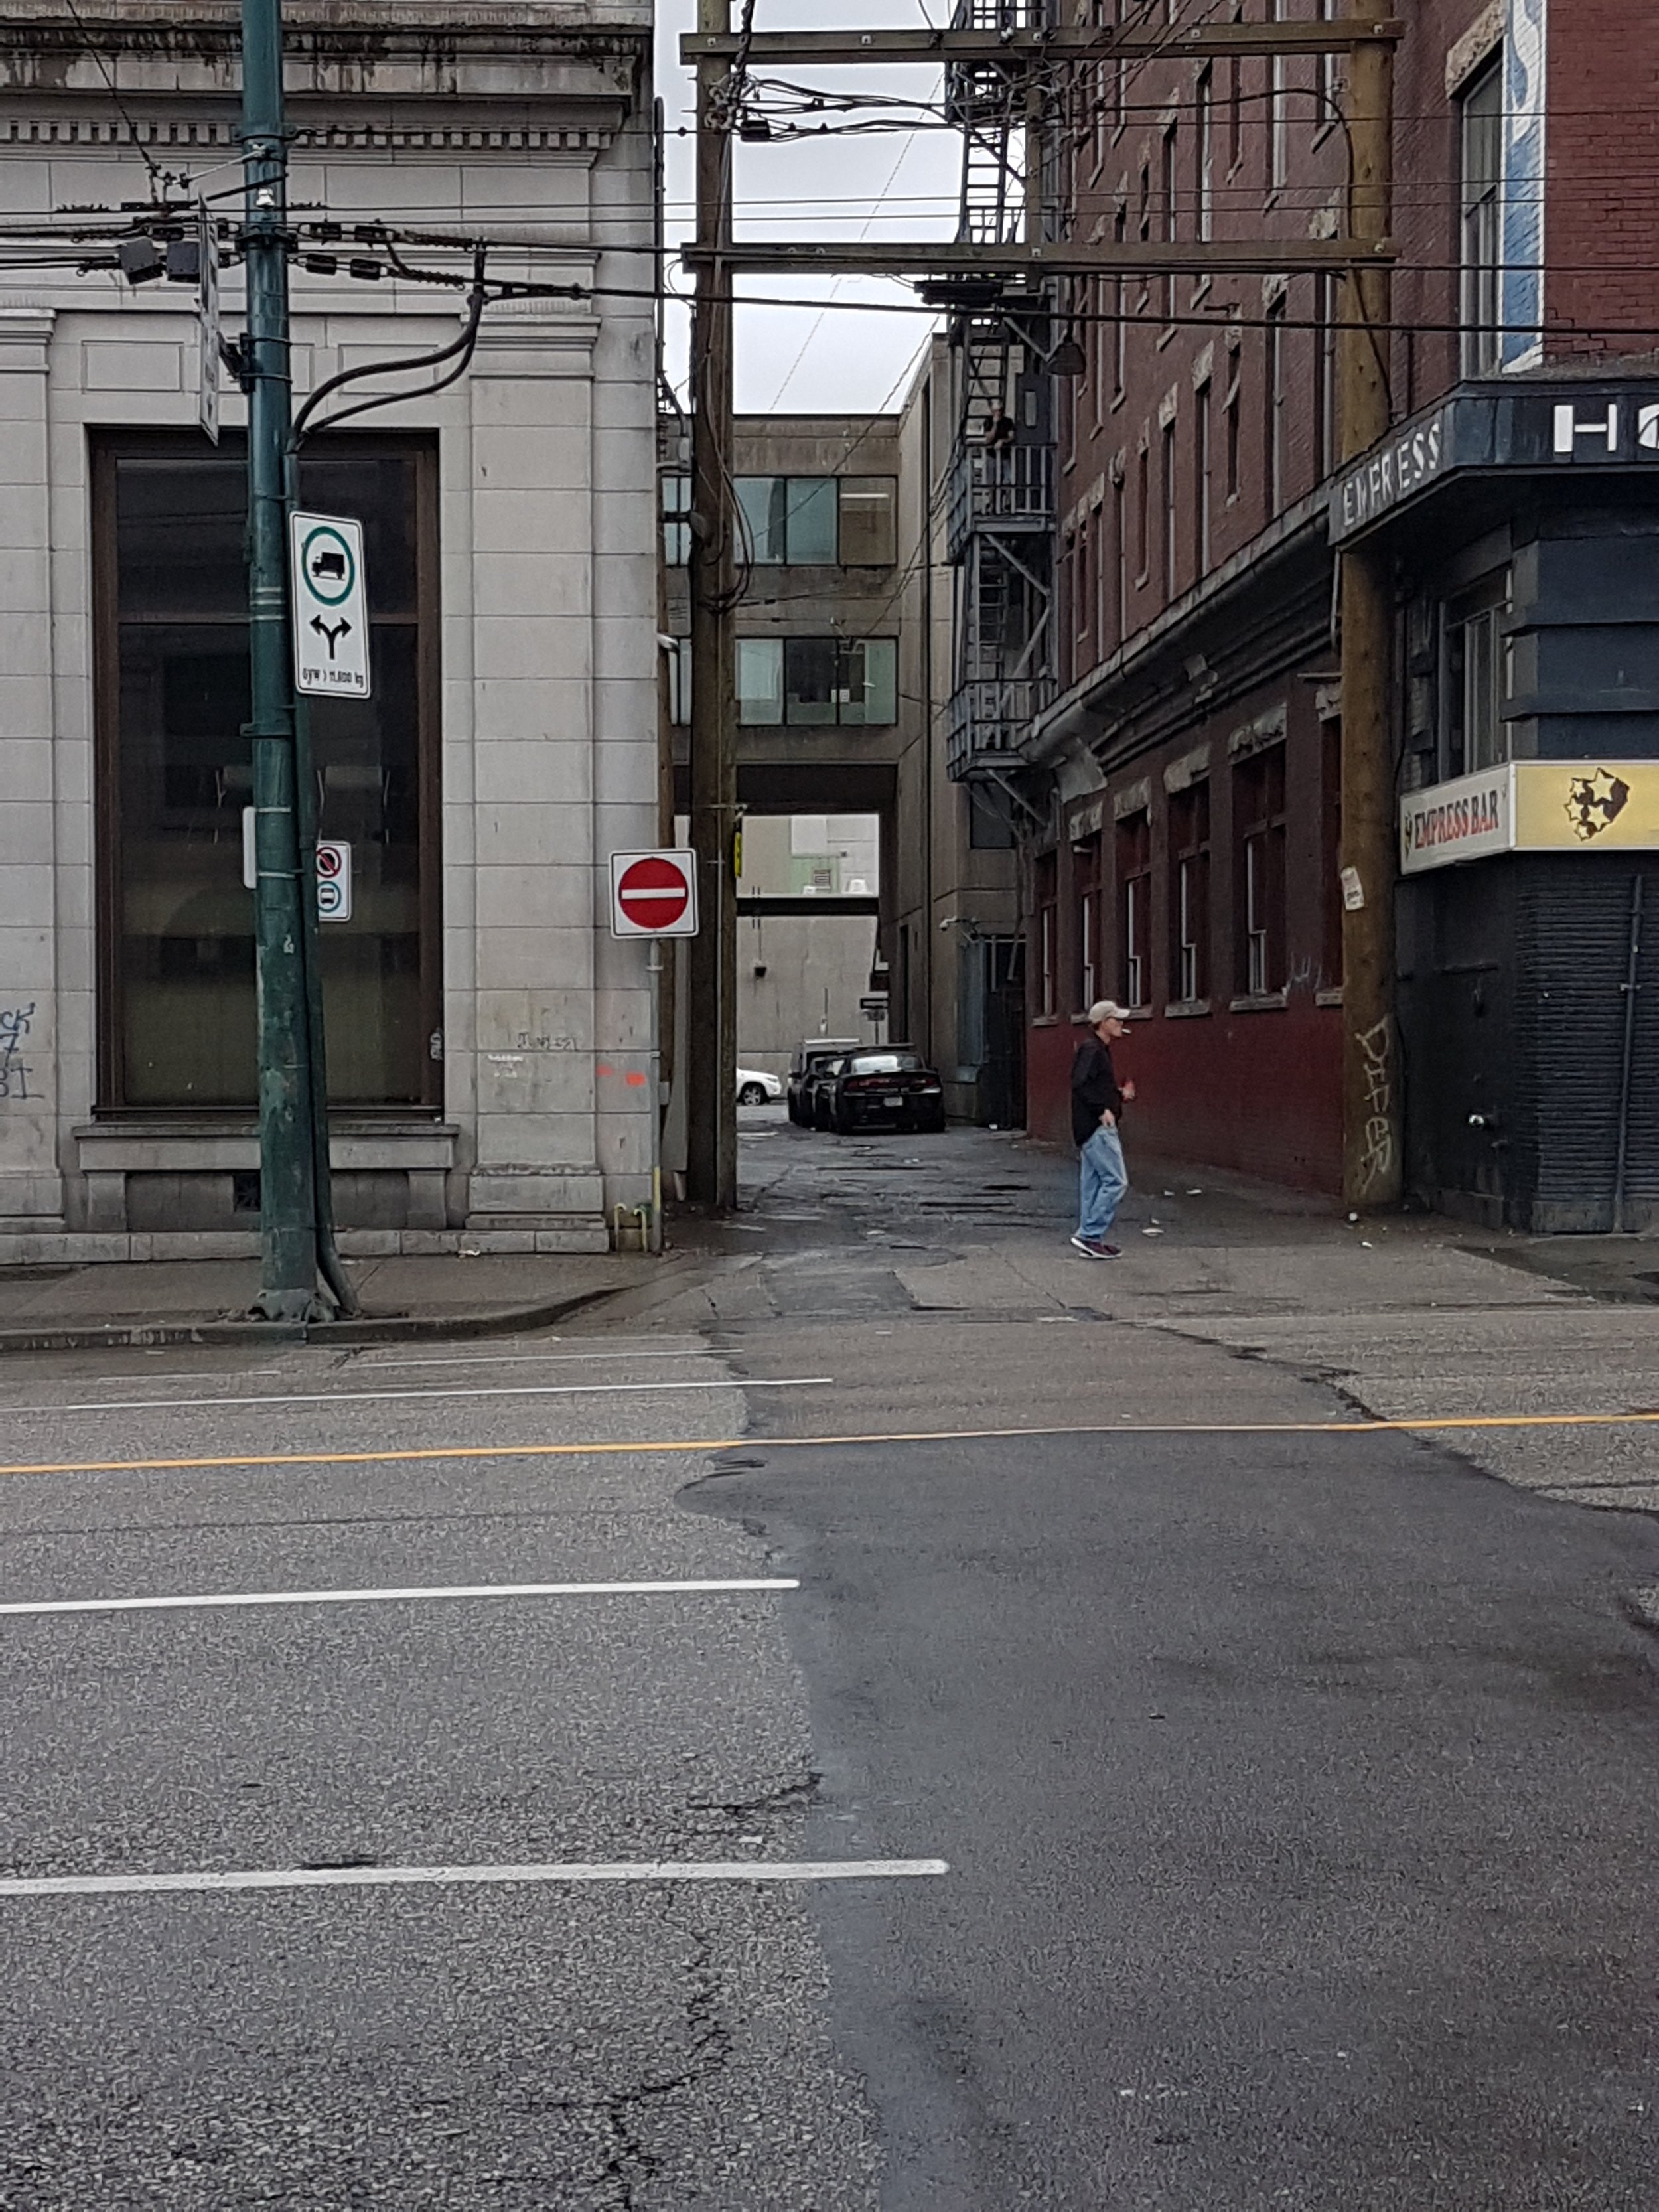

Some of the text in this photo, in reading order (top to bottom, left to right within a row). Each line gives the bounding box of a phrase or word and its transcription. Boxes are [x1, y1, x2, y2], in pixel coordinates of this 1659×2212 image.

[1344, 423, 1439, 526] EMPRESS
[1415, 790, 1498, 850] EMPRESS BAR
